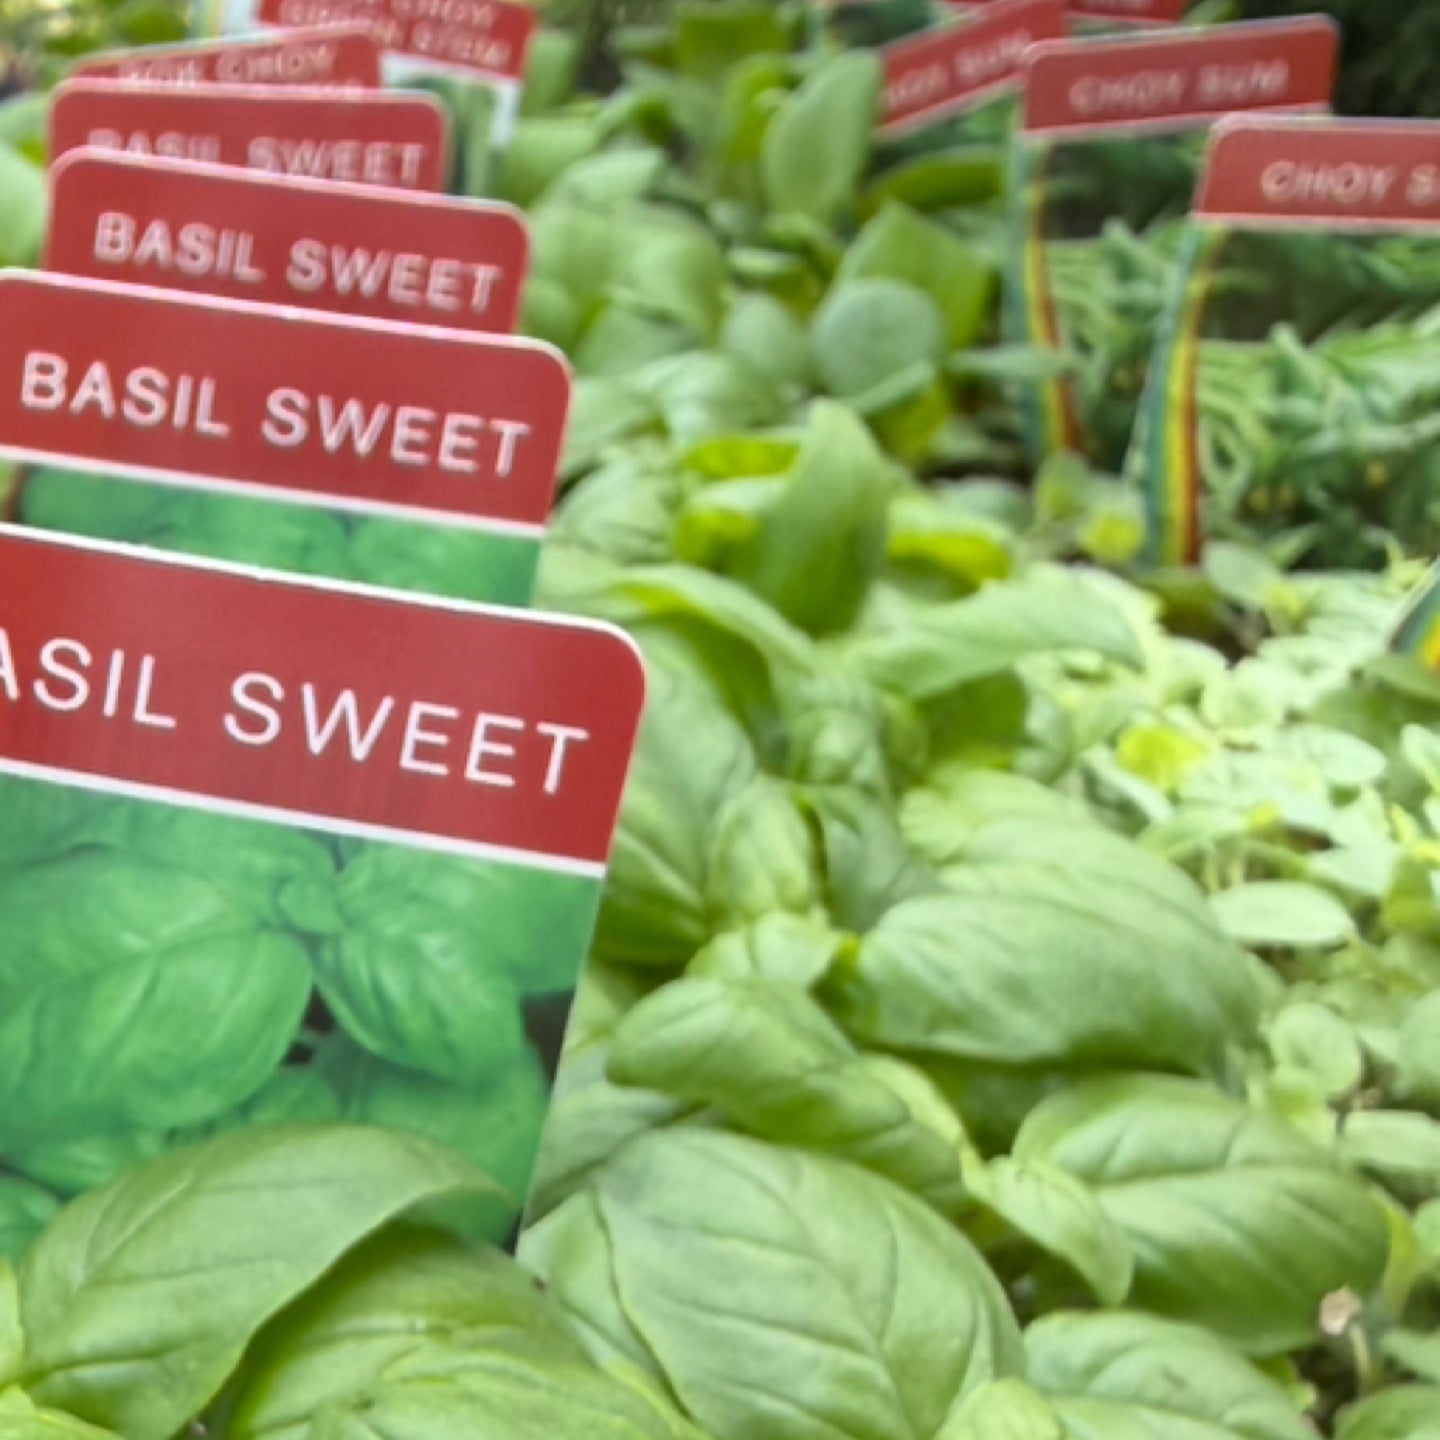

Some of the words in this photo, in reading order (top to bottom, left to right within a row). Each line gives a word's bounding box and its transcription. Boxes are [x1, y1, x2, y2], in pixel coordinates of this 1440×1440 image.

[1261, 161, 1398, 201] CHOY
[93, 211, 265, 283] BASIL
[286, 238, 504, 314] SWEET
[21, 350, 230, 438] BASIL
[261, 387, 531, 478] SWEET
[224, 672, 589, 794] SWEET
